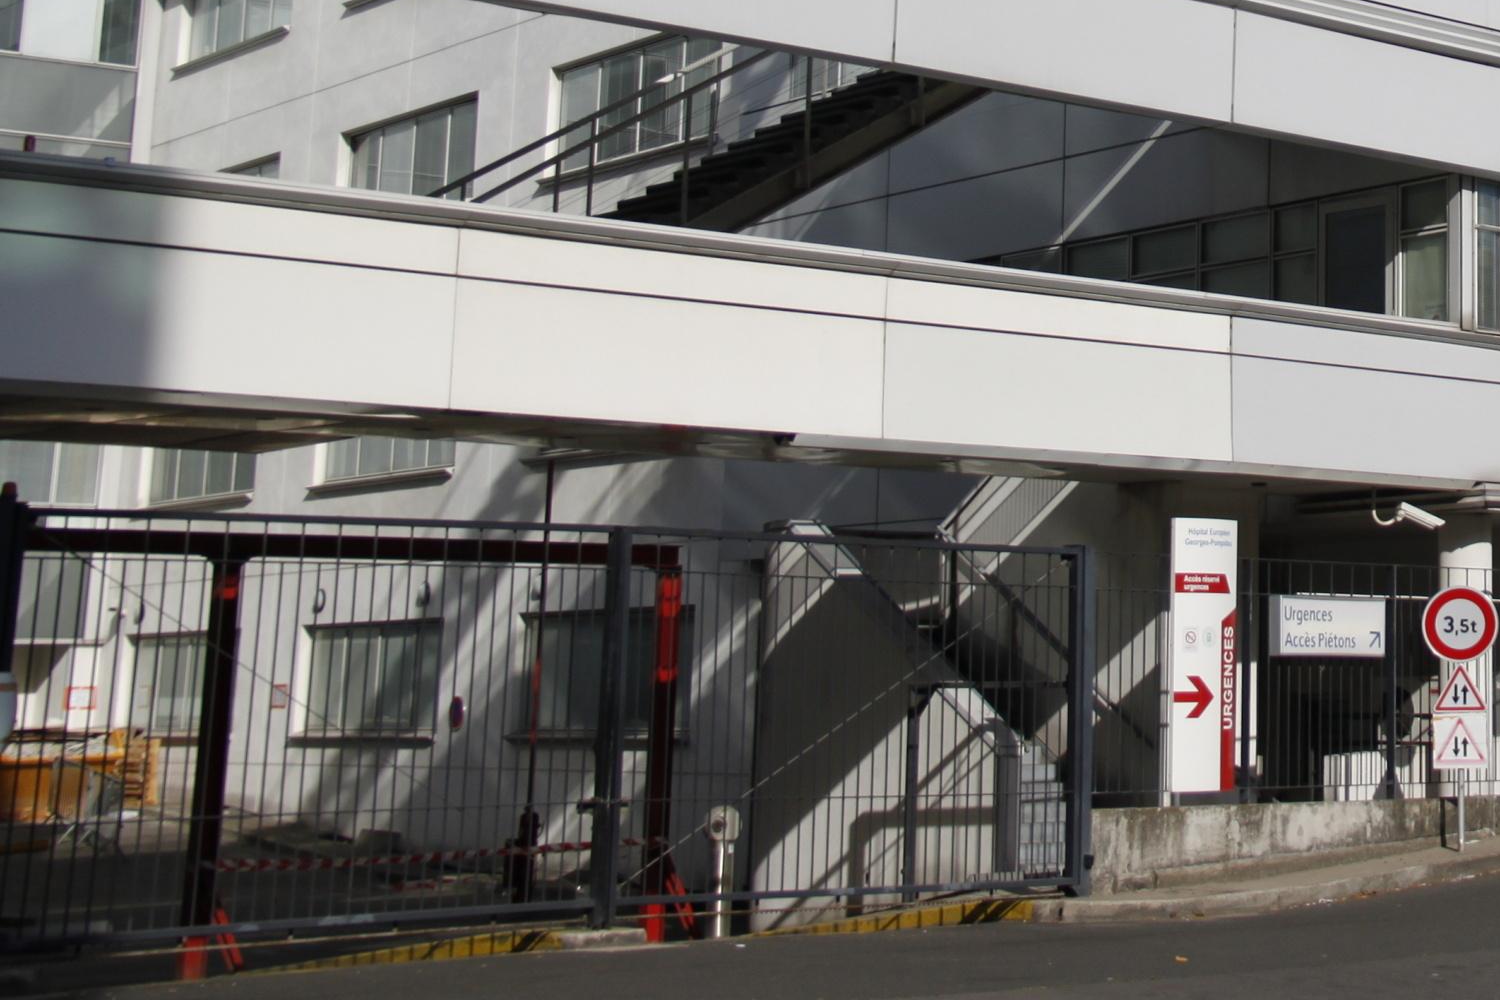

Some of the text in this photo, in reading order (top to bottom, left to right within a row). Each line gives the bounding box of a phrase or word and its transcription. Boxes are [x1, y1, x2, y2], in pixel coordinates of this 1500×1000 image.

[1284, 605, 1333, 626] Urgences
[1443, 615, 1478, 637] 3,5t
[1284, 631, 1357, 649] Accès Piétons
[1223, 626, 1235, 730] URGENCES
